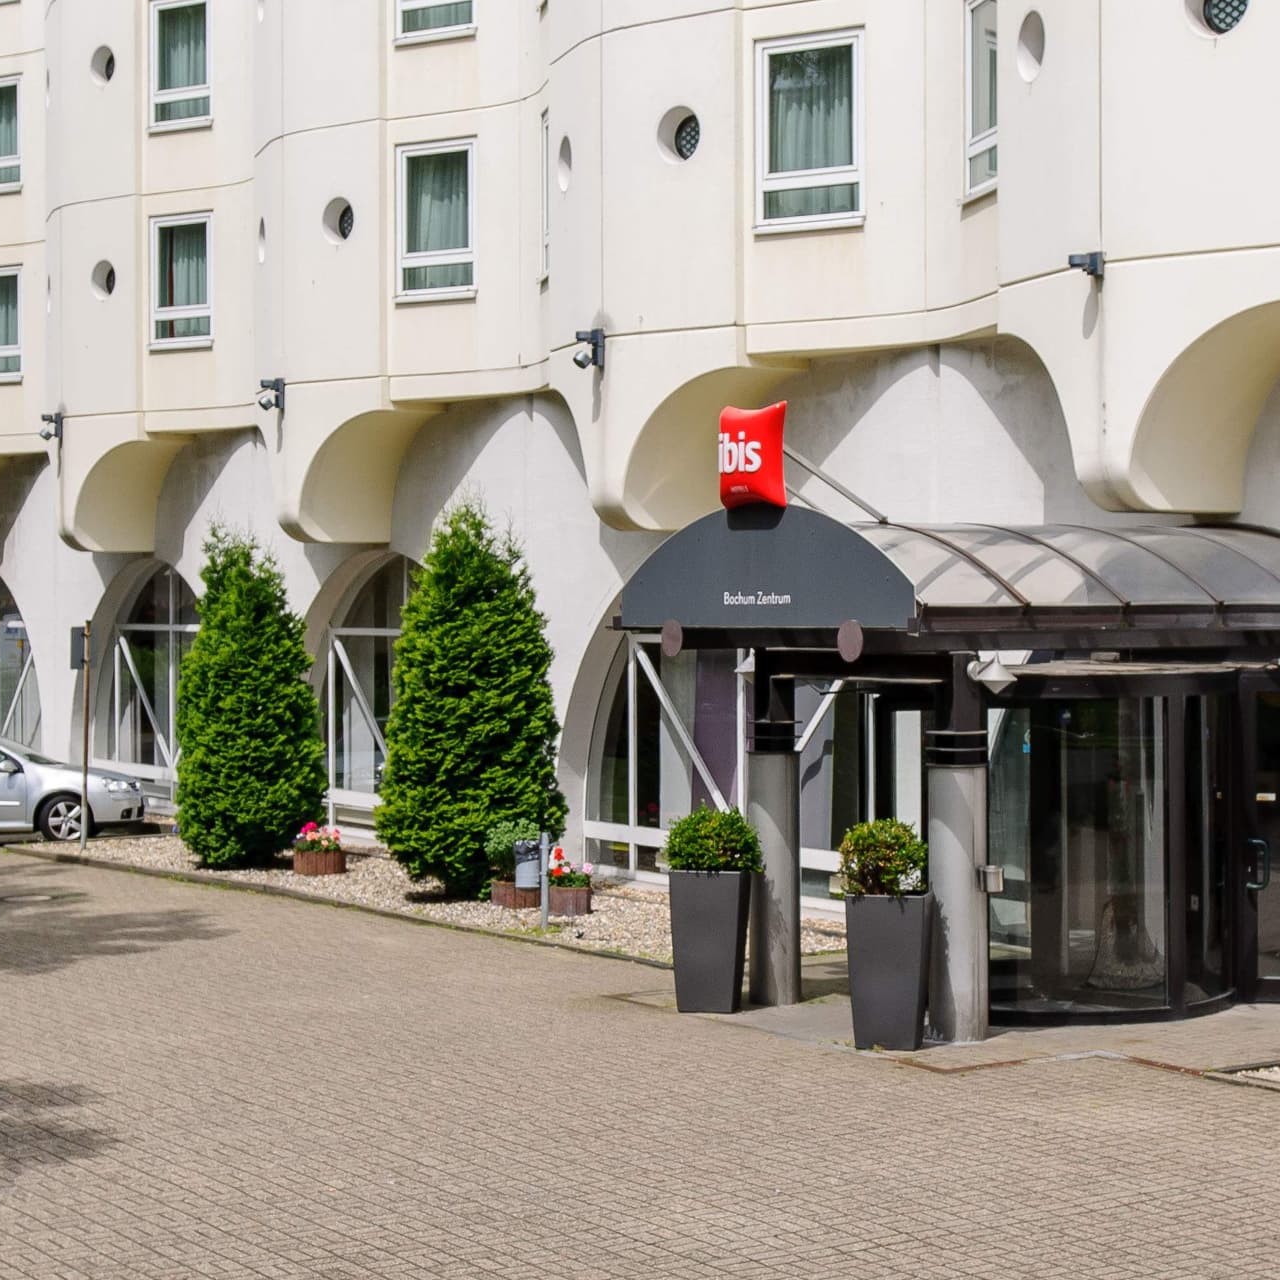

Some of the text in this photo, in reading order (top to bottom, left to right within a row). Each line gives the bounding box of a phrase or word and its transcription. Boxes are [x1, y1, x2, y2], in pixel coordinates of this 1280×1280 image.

[718, 431, 762, 473] ibis
[723, 591, 791, 605] Bochum Zentrum
